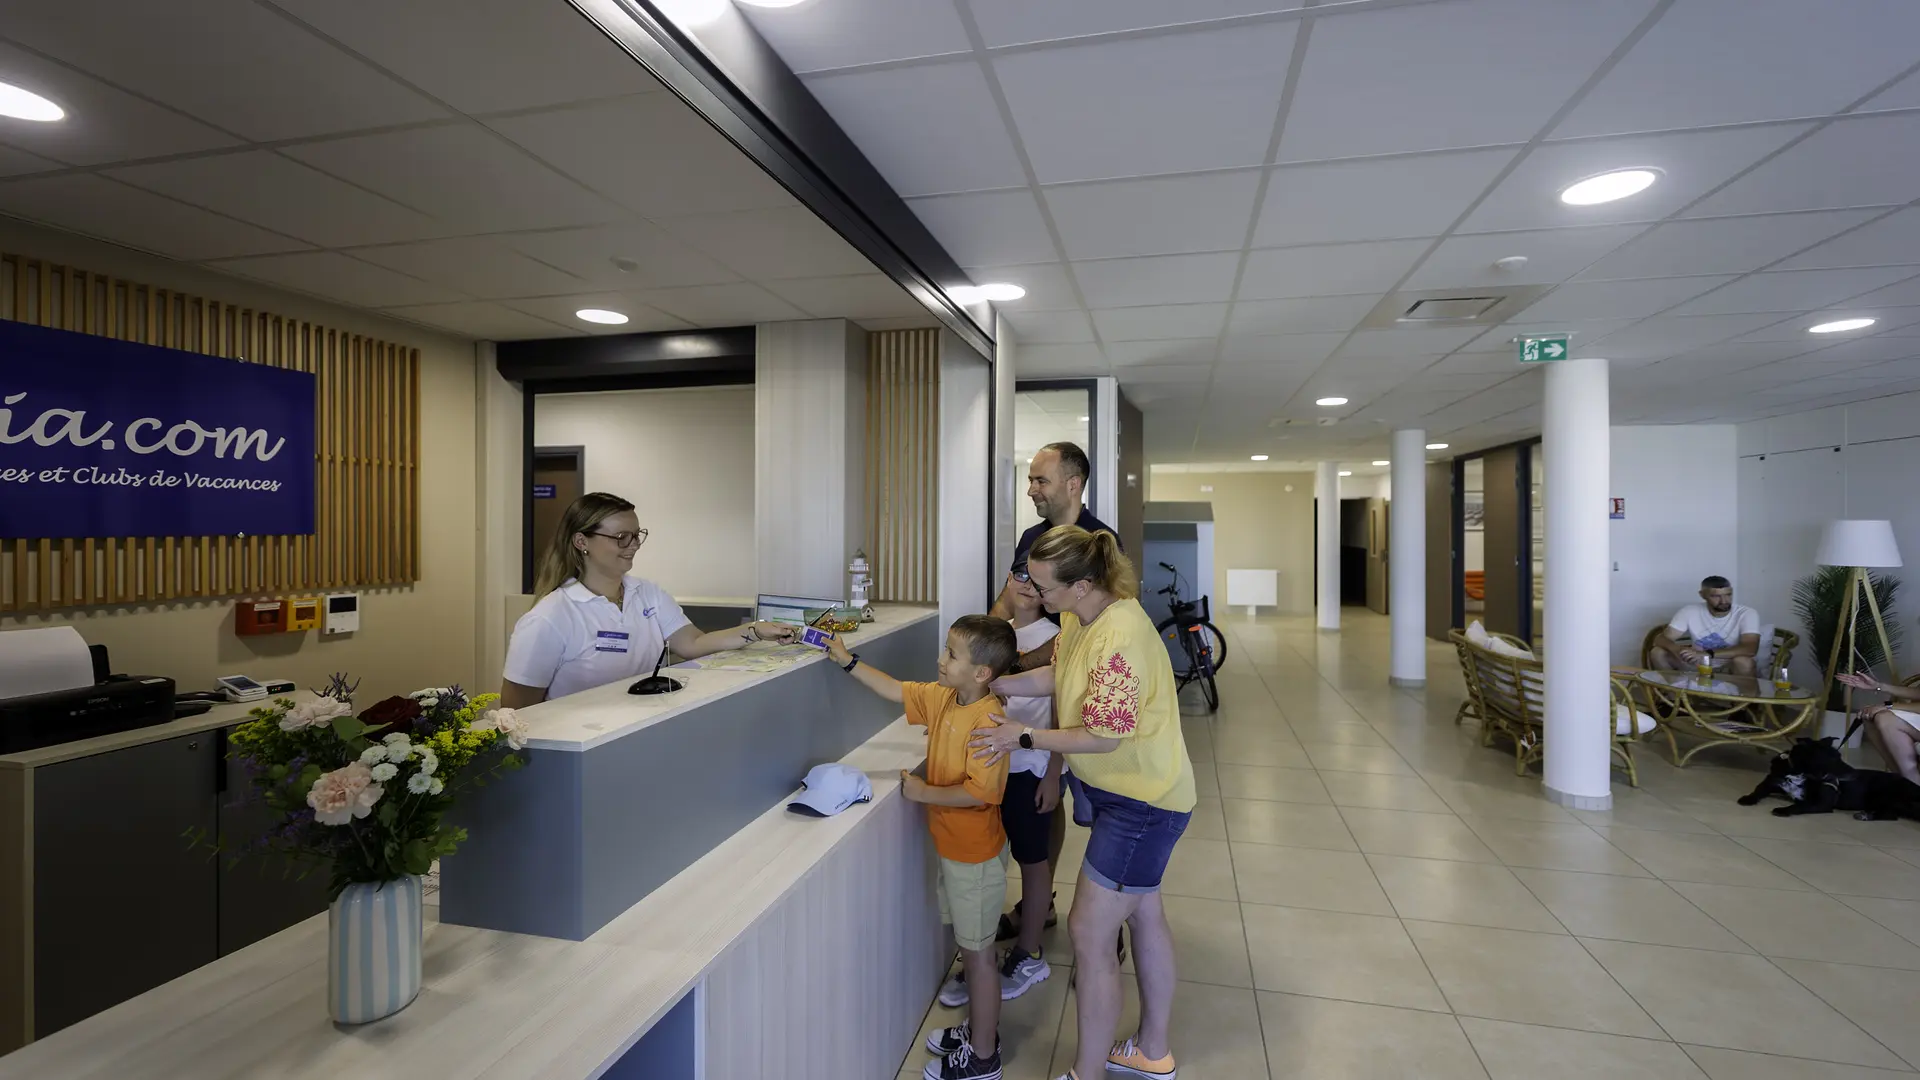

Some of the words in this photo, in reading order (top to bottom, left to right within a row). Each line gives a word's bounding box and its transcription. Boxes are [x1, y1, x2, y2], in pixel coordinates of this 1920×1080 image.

[0, 468, 35, 483] es
[39, 466, 70, 483] et
[73, 466, 146, 487] Clubs
[149, 470, 182, 487] de
[184, 472, 282, 492] Vacances
